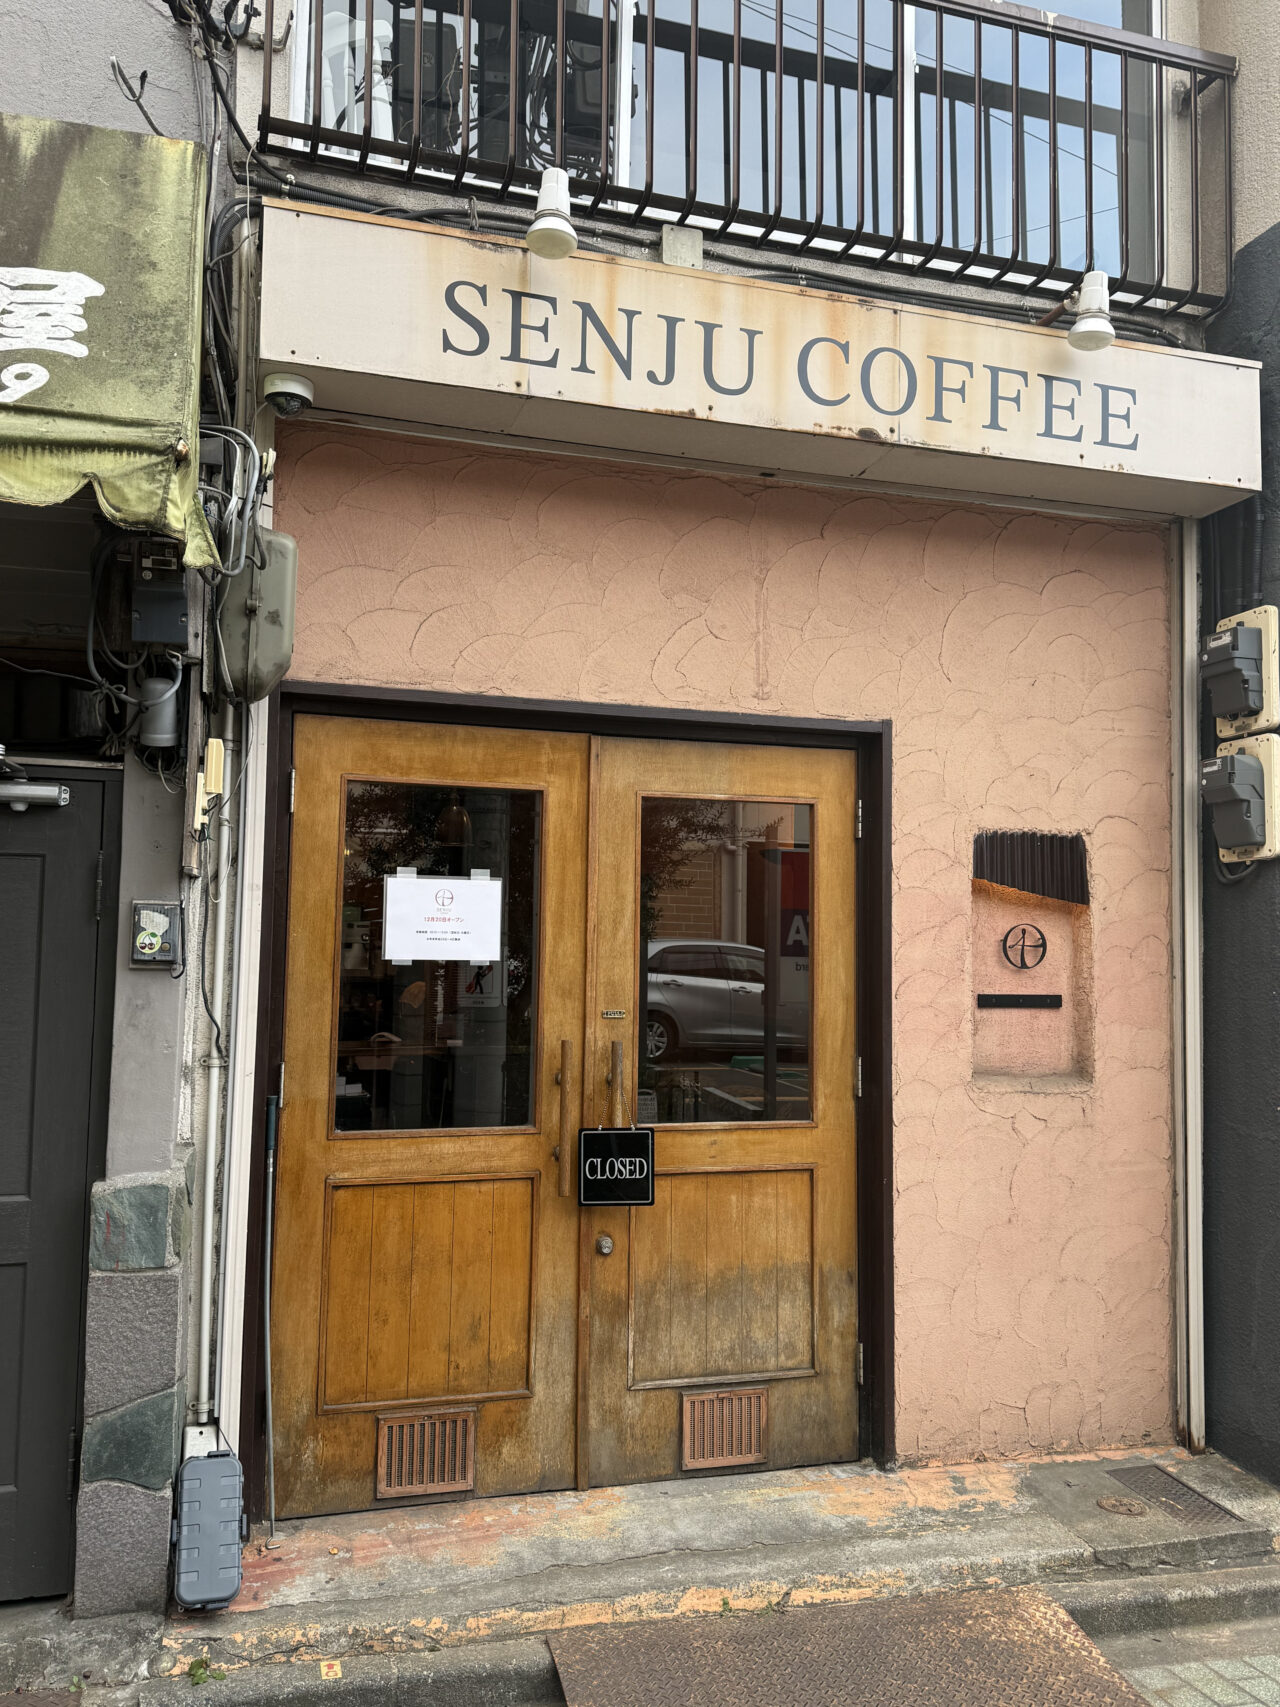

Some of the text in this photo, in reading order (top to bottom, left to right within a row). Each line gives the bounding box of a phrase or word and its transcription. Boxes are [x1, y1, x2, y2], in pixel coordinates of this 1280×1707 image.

[443, 281, 1139, 450] SENJU COFFEE
[585, 1157, 648, 1180] CLOSED
